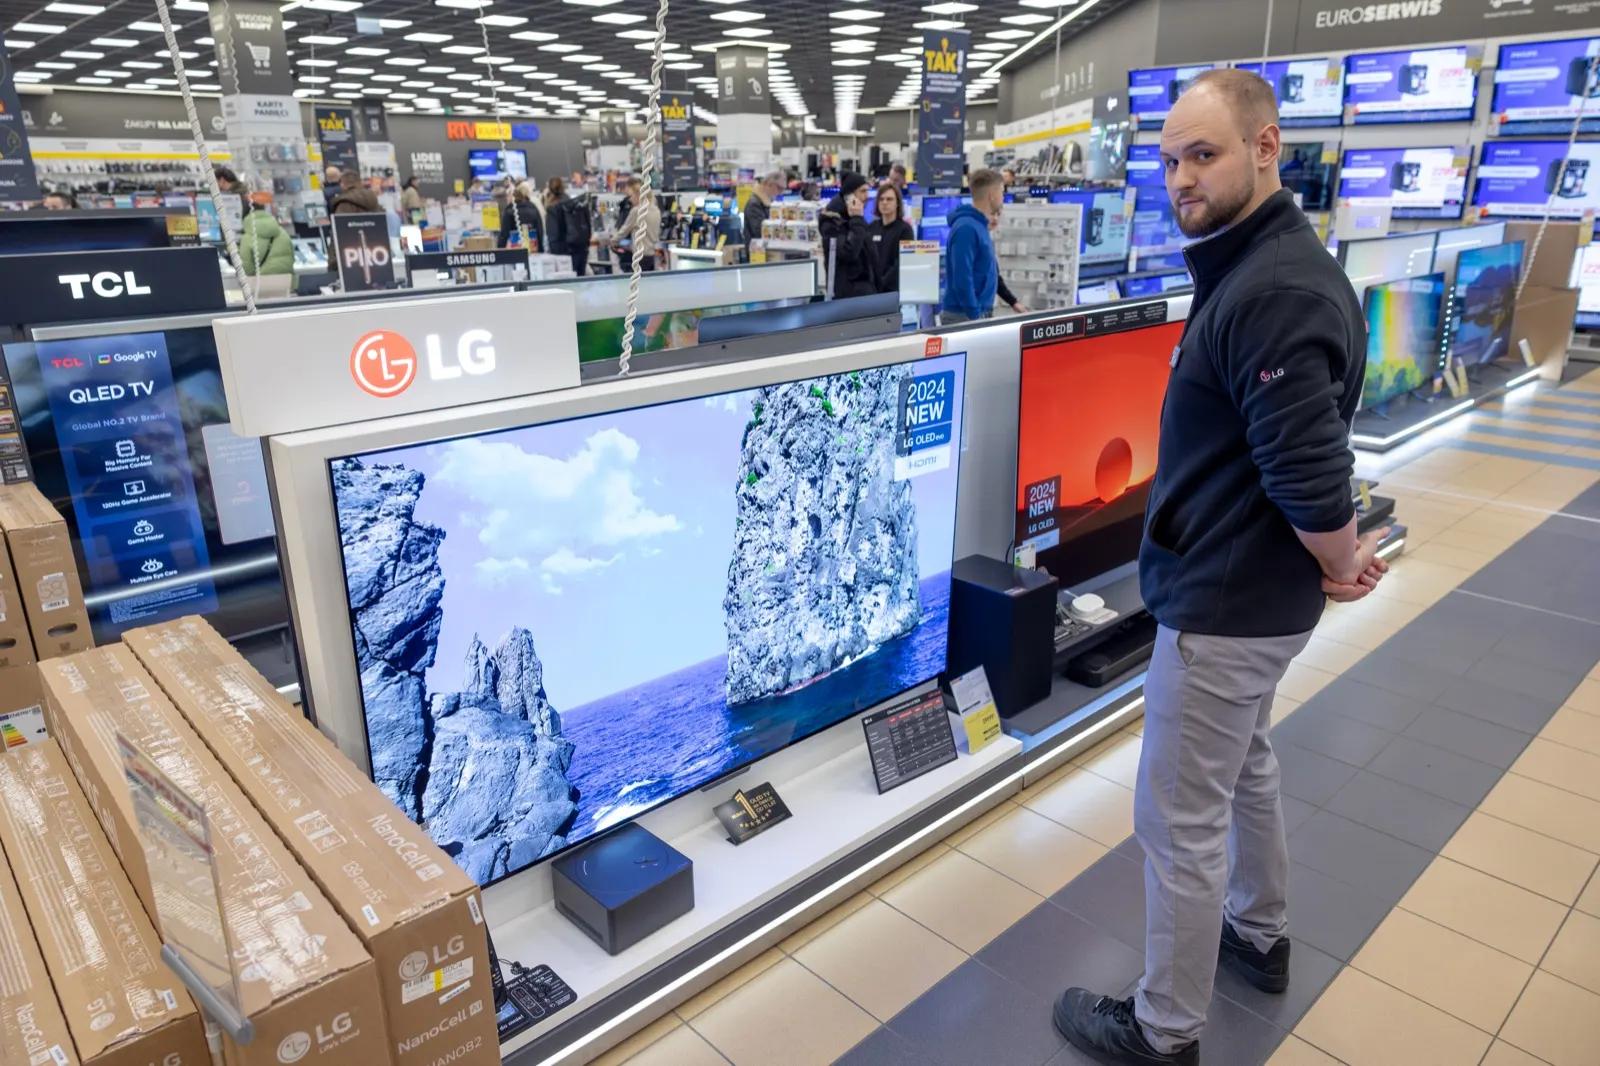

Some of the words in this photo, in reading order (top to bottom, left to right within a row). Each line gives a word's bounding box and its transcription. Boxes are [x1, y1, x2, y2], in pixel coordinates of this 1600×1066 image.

[1315, 0, 1443, 28] EUROSERWIS
[925, 49, 964, 74] TAK!
[157, 120, 171, 130] NA
[447, 121, 476, 141] RTV
[446, 252, 496, 266] SAMSUNG
[58, 270, 151, 300] TCL
[1033, 328, 1044, 340] LG
[1045, 324, 1067, 337] OLED
[51, 357, 85, 369] TCL
[113, 352, 145, 363] Google
[146, 349, 158, 359] TV
[424, 328, 496, 382] LG
[1271, 367, 1285, 379] LG
[69, 384, 126, 405] QLED
[127, 379, 155, 398] TV
[906, 376, 946, 405] 2024
[72, 419, 102, 432] Global
[103, 417, 126, 428] NO.2
[126, 415, 139, 424] TV
[140, 411, 166, 422] Brand
[906, 400, 945, 427] NEW
[903, 437, 914, 449] LG
[105, 464, 129, 473] Massive
[129, 460, 153, 469] Content
[115, 456, 140, 465] Memory
[120, 498, 139, 506] Game
[139, 492, 172, 503] Accelerator
[1029, 479, 1056, 503] 2024
[1029, 497, 1056, 519] NEW
[1028, 523, 1038, 534] LG
[1038, 517, 1055, 531] OLED
[127, 538, 145, 546] Game
[145, 533, 164, 542] Master
[129, 575, 153, 585] Multiple
[152, 572, 165, 581] Eye
[164, 569, 178, 577] Care
[368, 813, 430, 870] NanoCell
[432, 934, 465, 965] LG
[15, 1002, 48, 1056] NanoCell
[315, 1011, 352, 1045] LG
[398, 1008, 468, 1056] NanoCell
